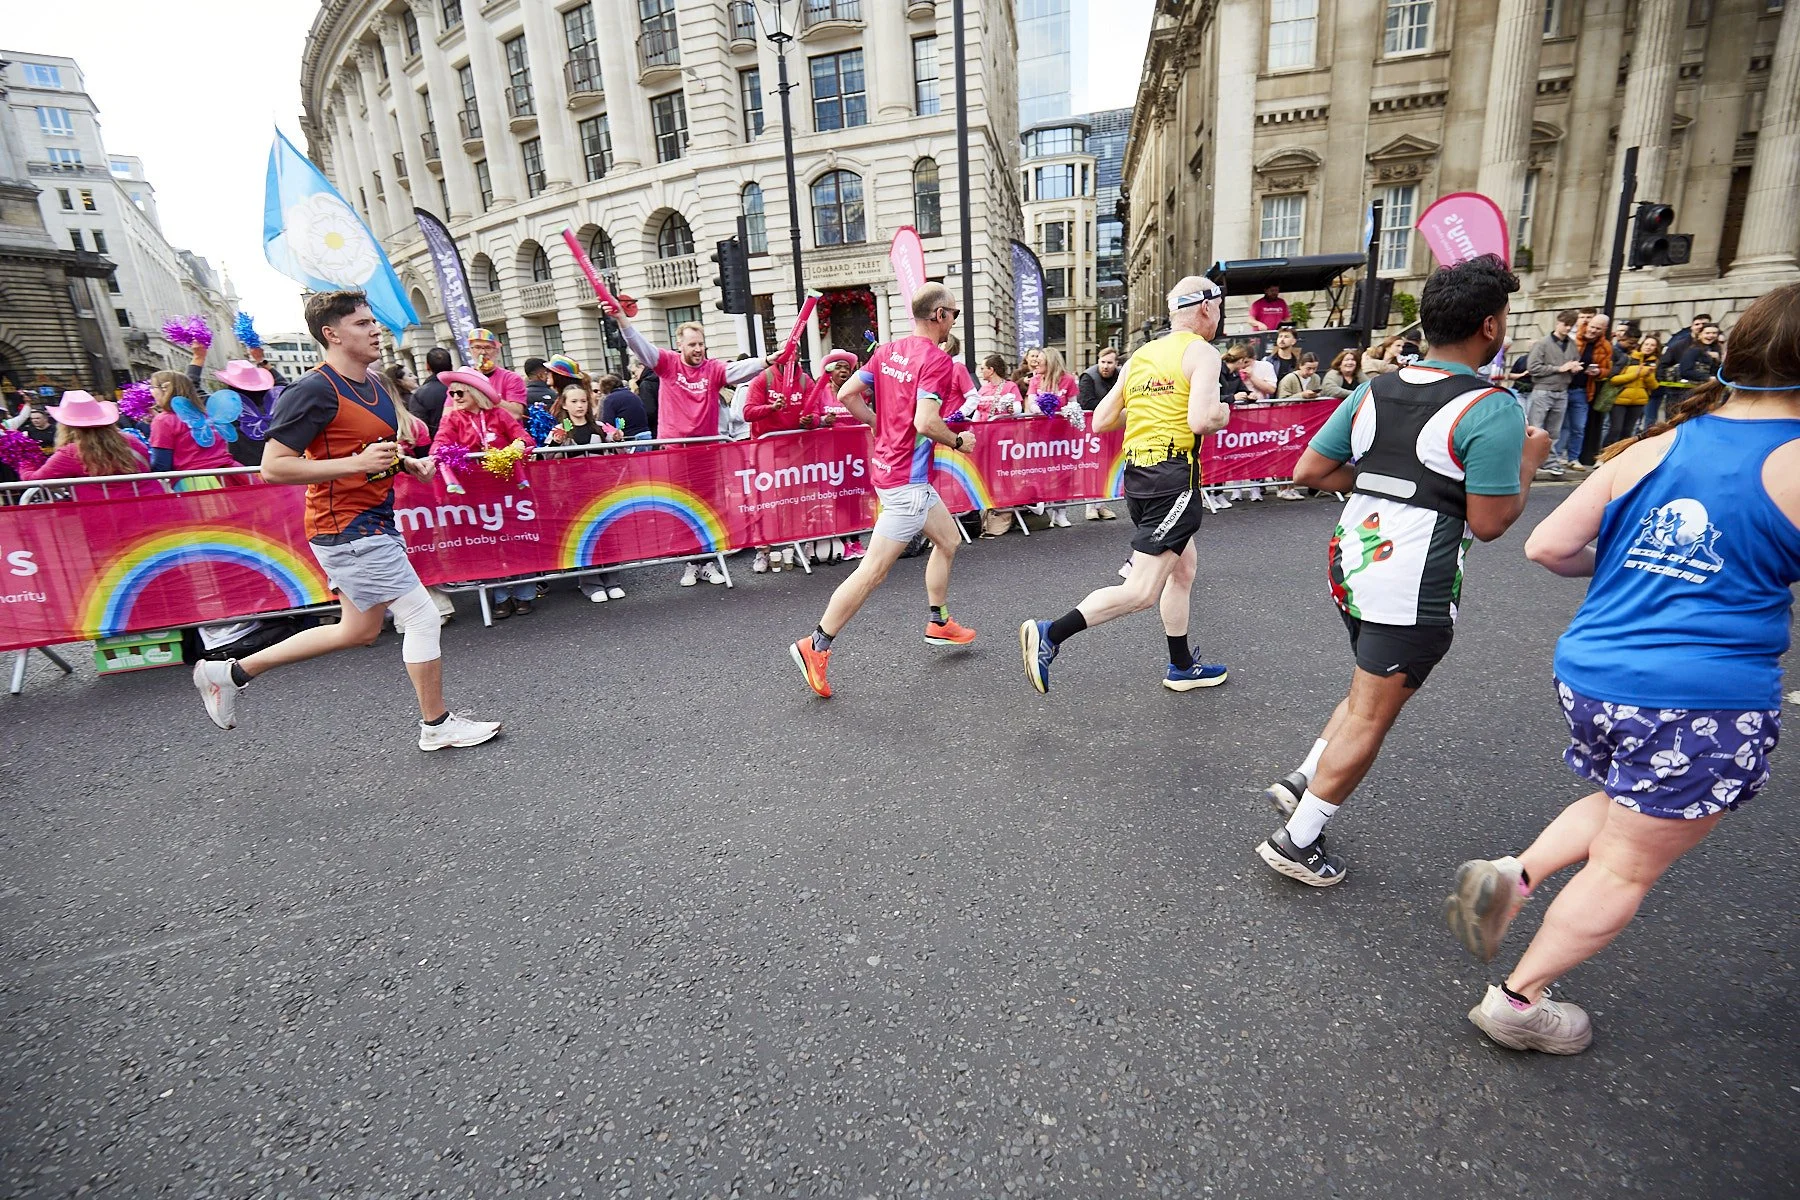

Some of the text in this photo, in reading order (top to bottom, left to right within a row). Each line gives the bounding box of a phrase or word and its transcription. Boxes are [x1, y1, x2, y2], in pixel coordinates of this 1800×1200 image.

[812, 263, 850, 274] LOMBARD
[853, 260, 881, 270] STREET
[997, 432, 1101, 461] Tommy's
[1215, 423, 1306, 449] Tommy's
[734, 453, 866, 496] Tommy's
[996, 461, 1099, 477] The pregnancy and baby charity
[738, 486, 866, 514] The pregnancy and baby charity
[393, 494, 537, 533] mmy's
[438, 535, 463, 550] and
[465, 533, 497, 546] baby
[500, 531, 540, 543] charity
[1623, 559, 1708, 585] STRIDERS
